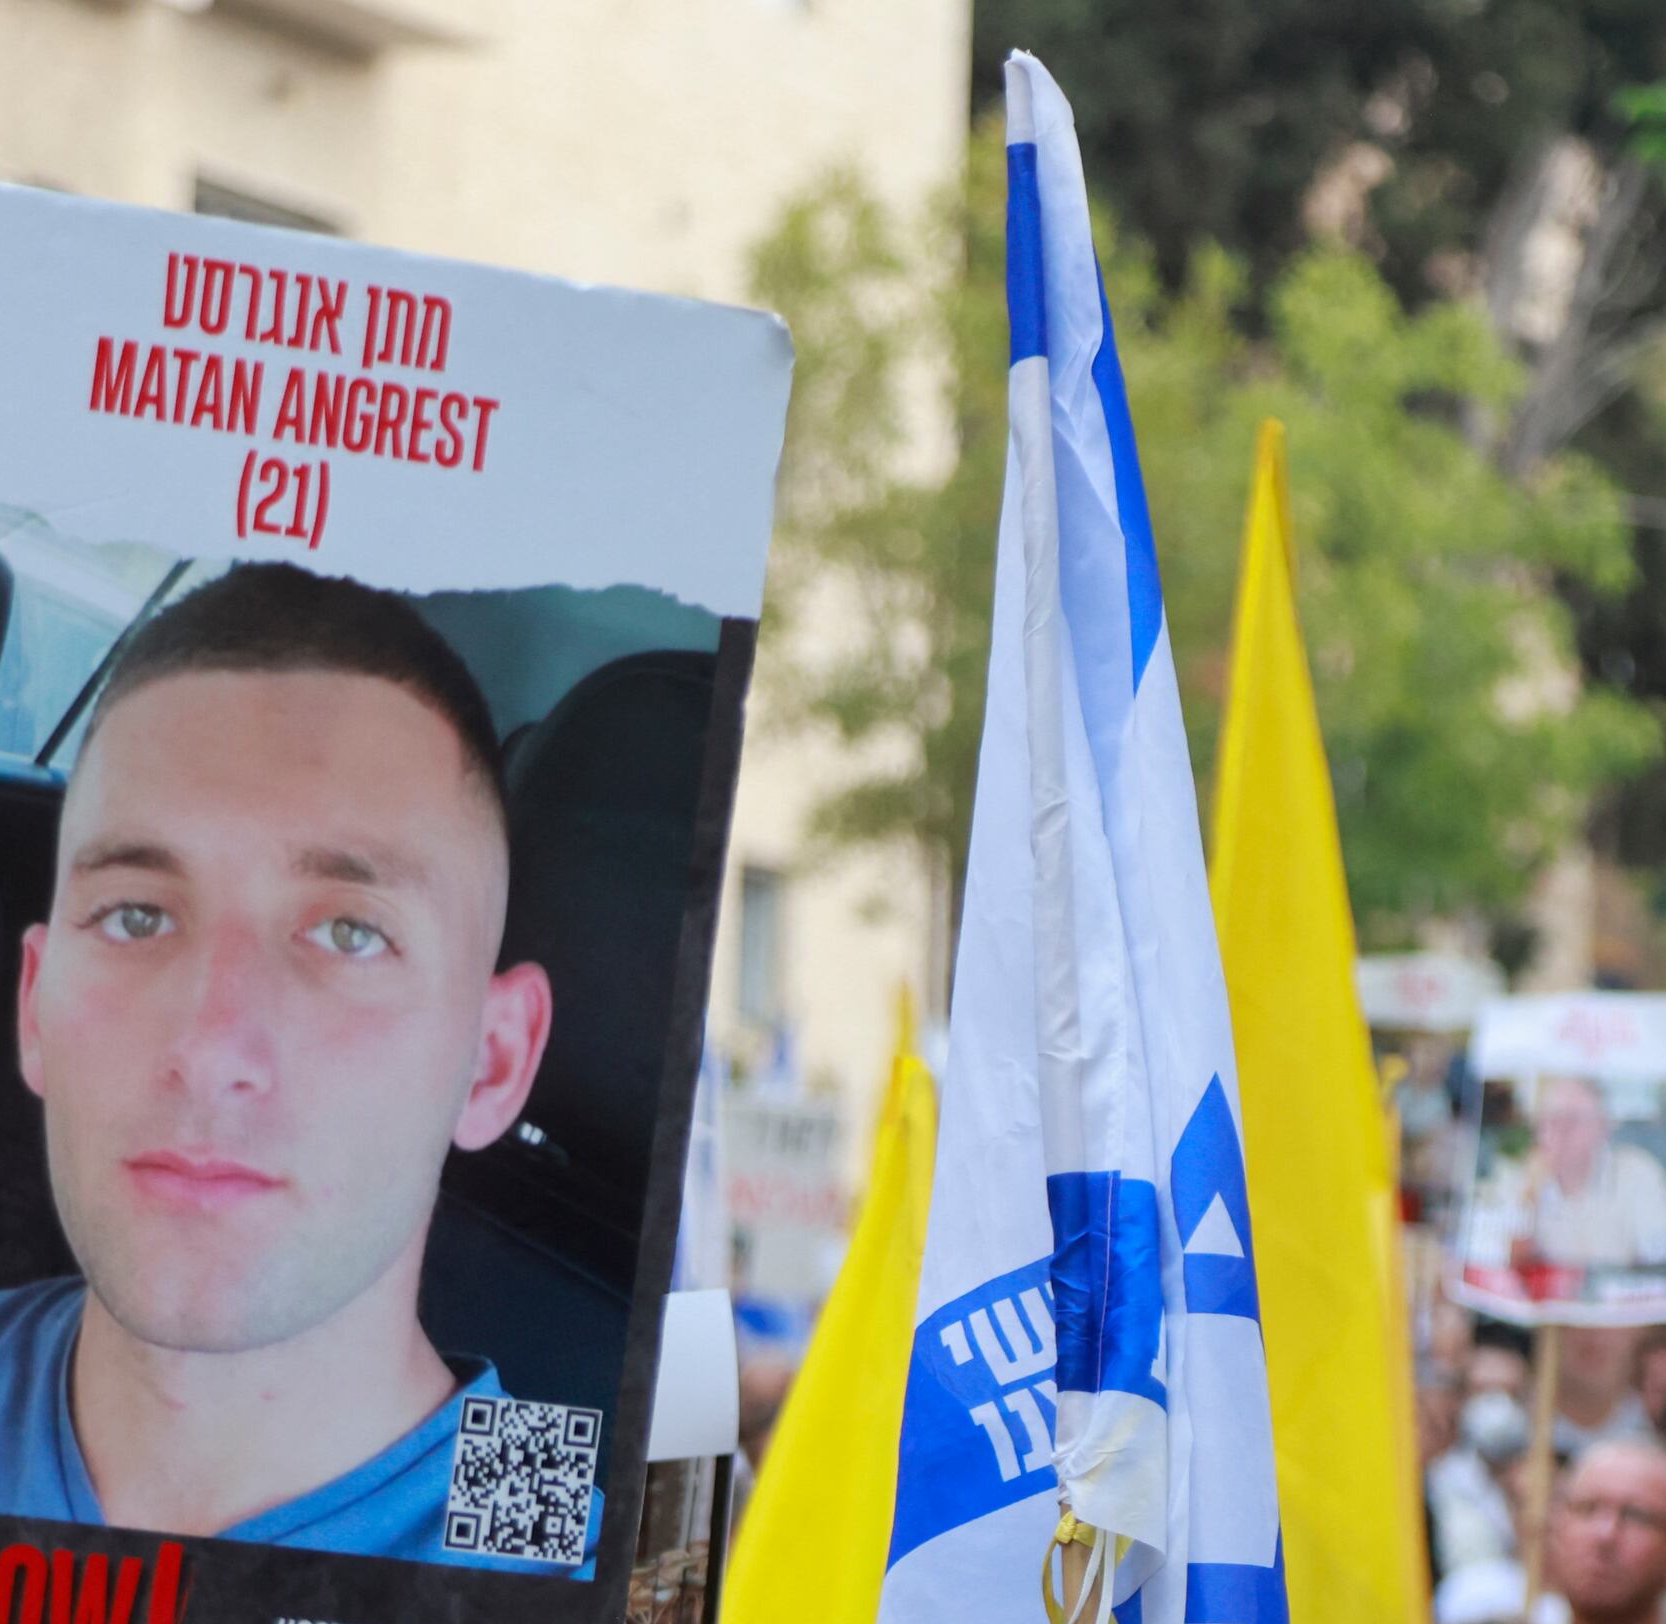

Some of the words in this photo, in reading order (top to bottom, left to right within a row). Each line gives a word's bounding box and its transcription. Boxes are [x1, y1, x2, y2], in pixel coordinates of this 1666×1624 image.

[162, 251, 349, 355] אנגרסט
[362, 284, 453, 372] מתן
[89, 335, 265, 436] MATAN
[273, 367, 501, 472] ANGREST
[236, 449, 331, 550] (21)
